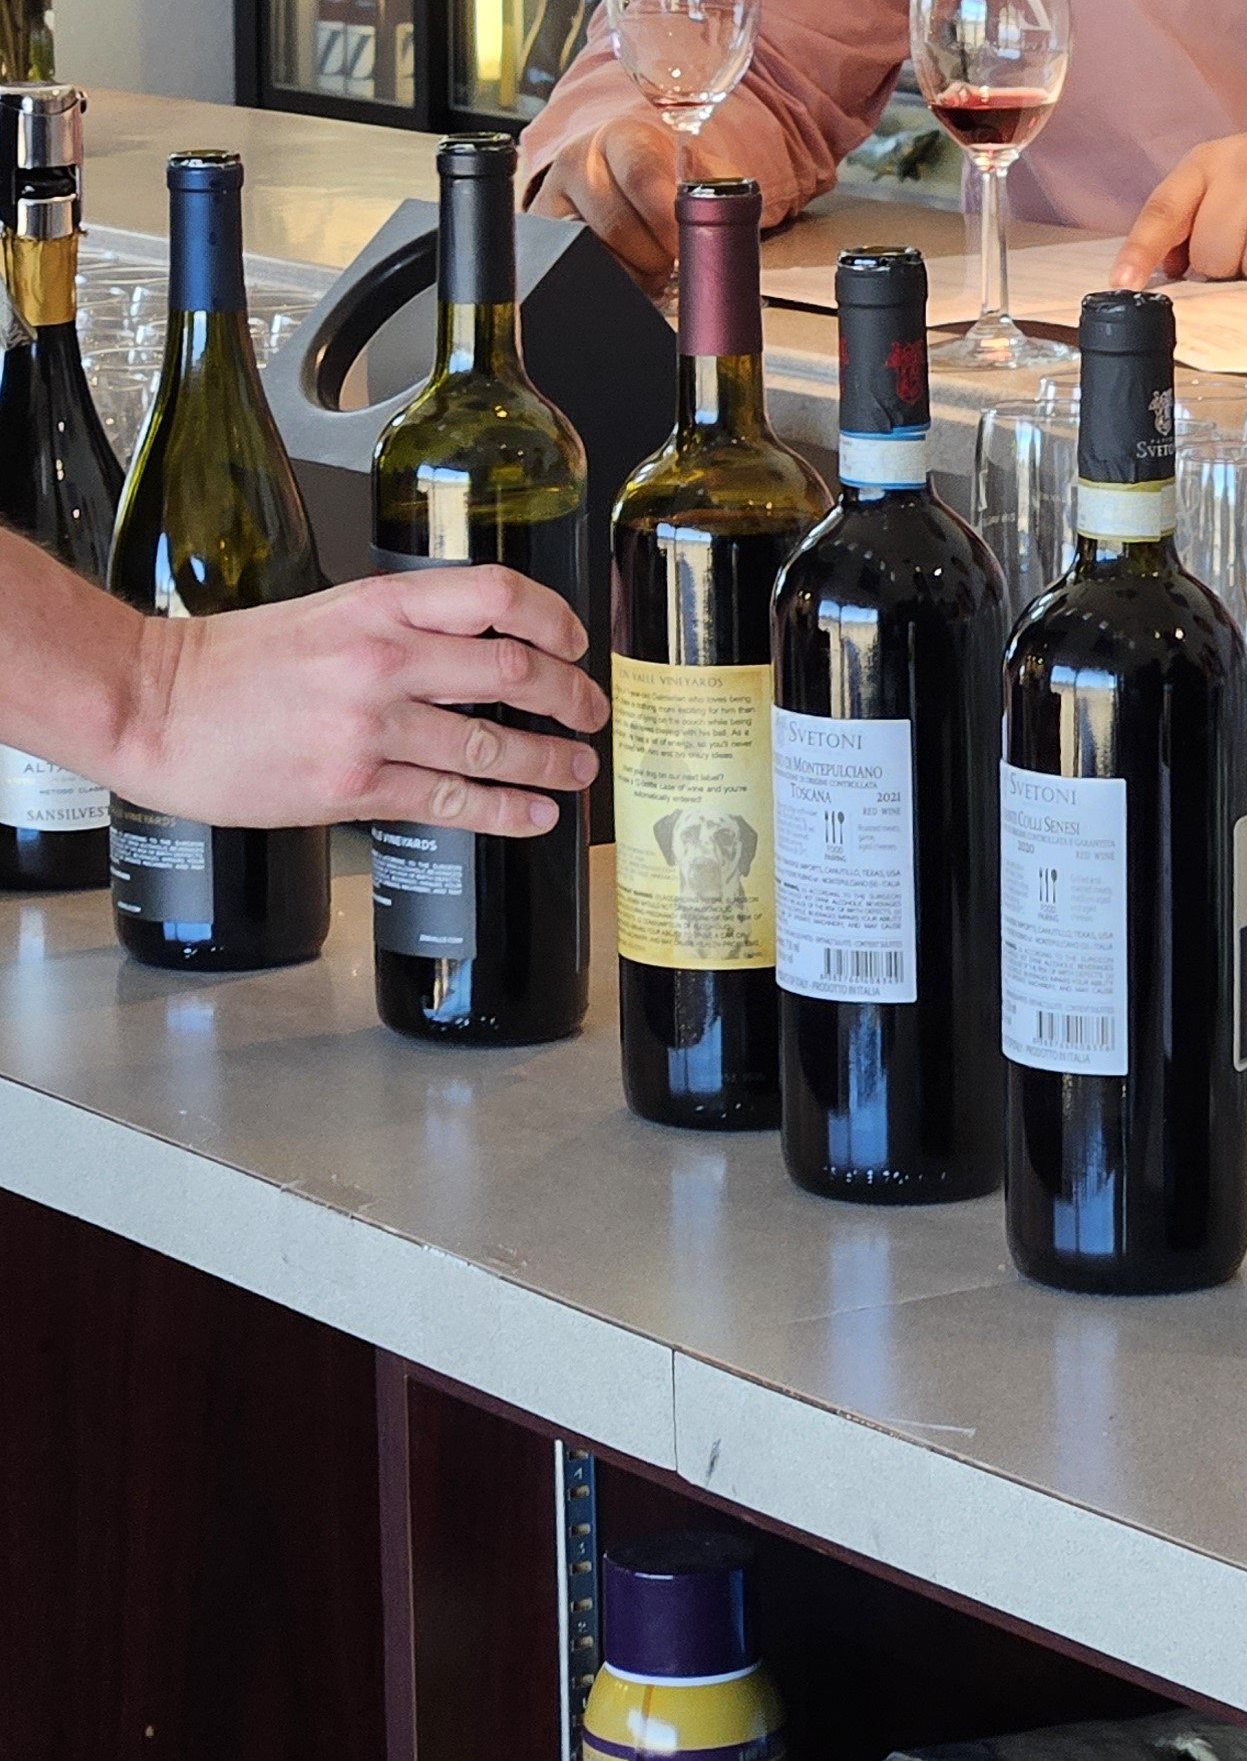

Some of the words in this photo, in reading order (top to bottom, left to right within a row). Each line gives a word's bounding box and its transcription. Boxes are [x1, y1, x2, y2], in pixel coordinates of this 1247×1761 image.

[660, 676, 723, 688] VINEYARDS
[877, 792, 901, 803] 2021
[1044, 816, 1080, 835] SENESI
